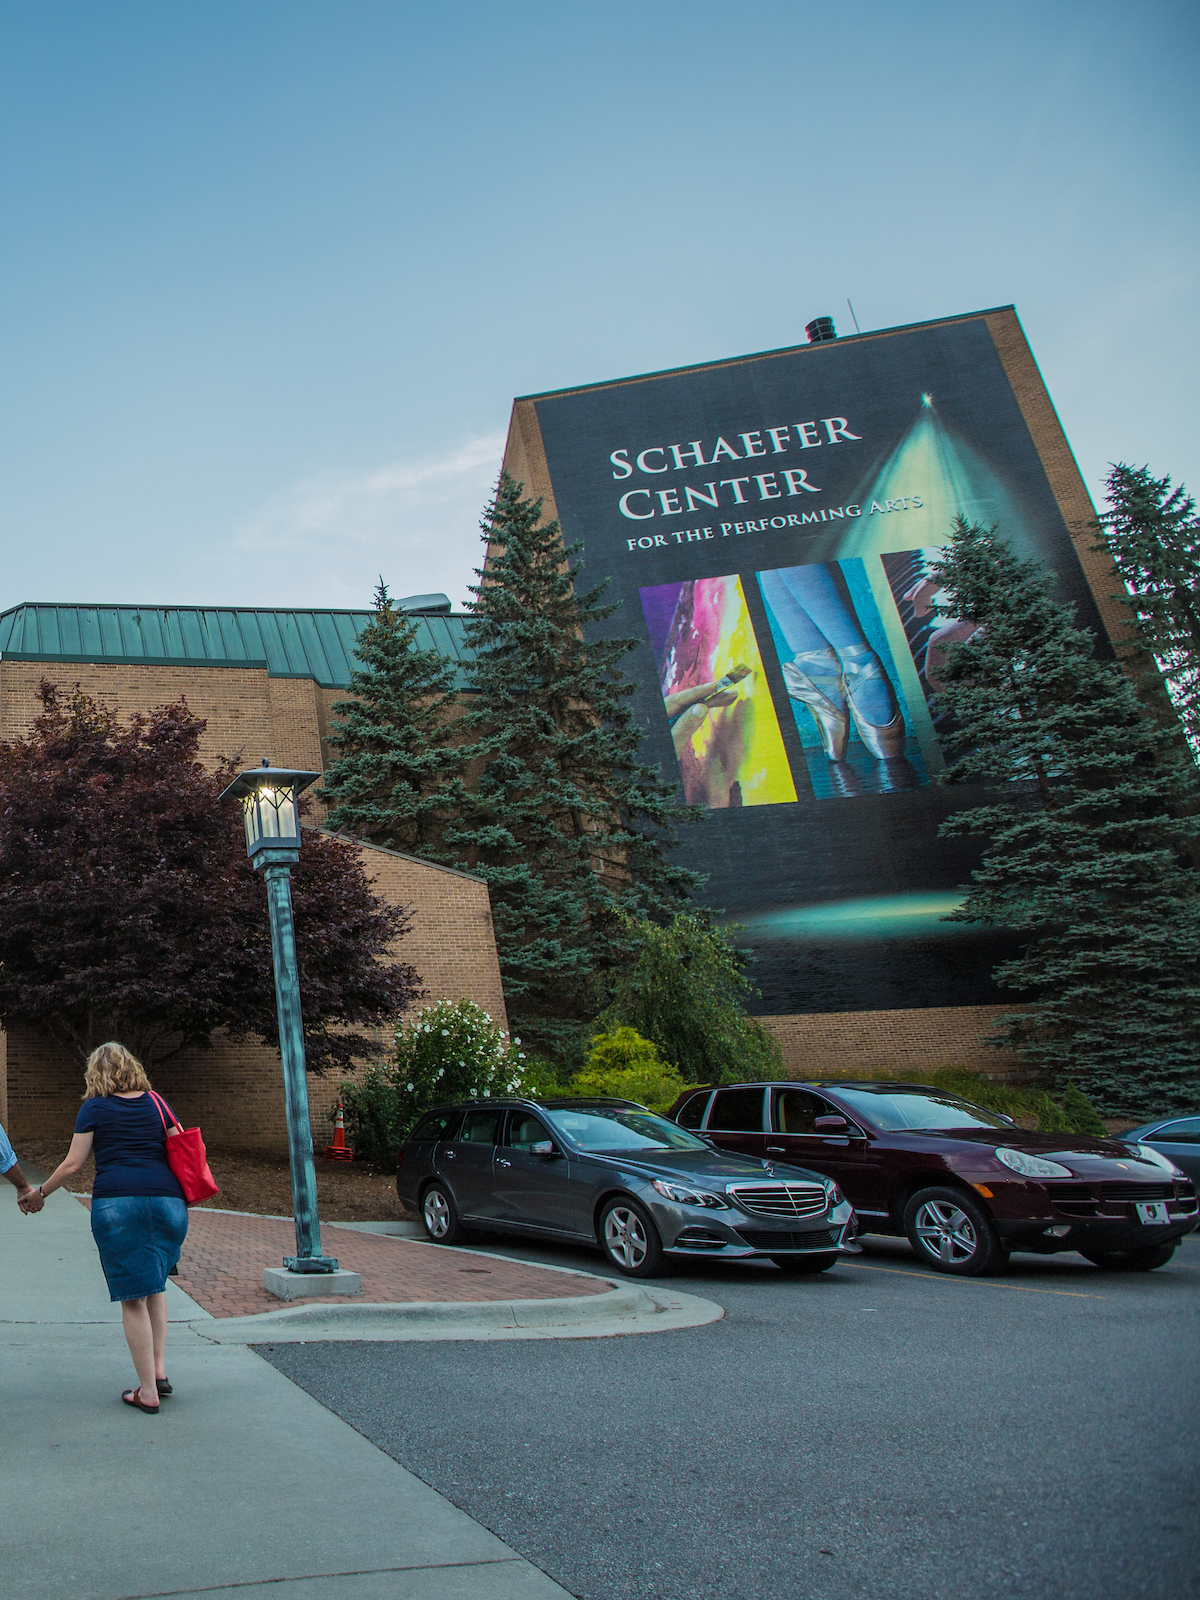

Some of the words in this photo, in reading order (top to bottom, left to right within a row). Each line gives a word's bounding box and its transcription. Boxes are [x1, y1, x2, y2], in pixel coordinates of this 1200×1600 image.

[609, 416, 863, 480] SCHAEFER
[618, 467, 822, 520] CENTER
[626, 534, 668, 551] FOR
[672, 527, 714, 544] THE
[720, 504, 862, 537] PERFORMING
[868, 494, 924, 515] ARTS
